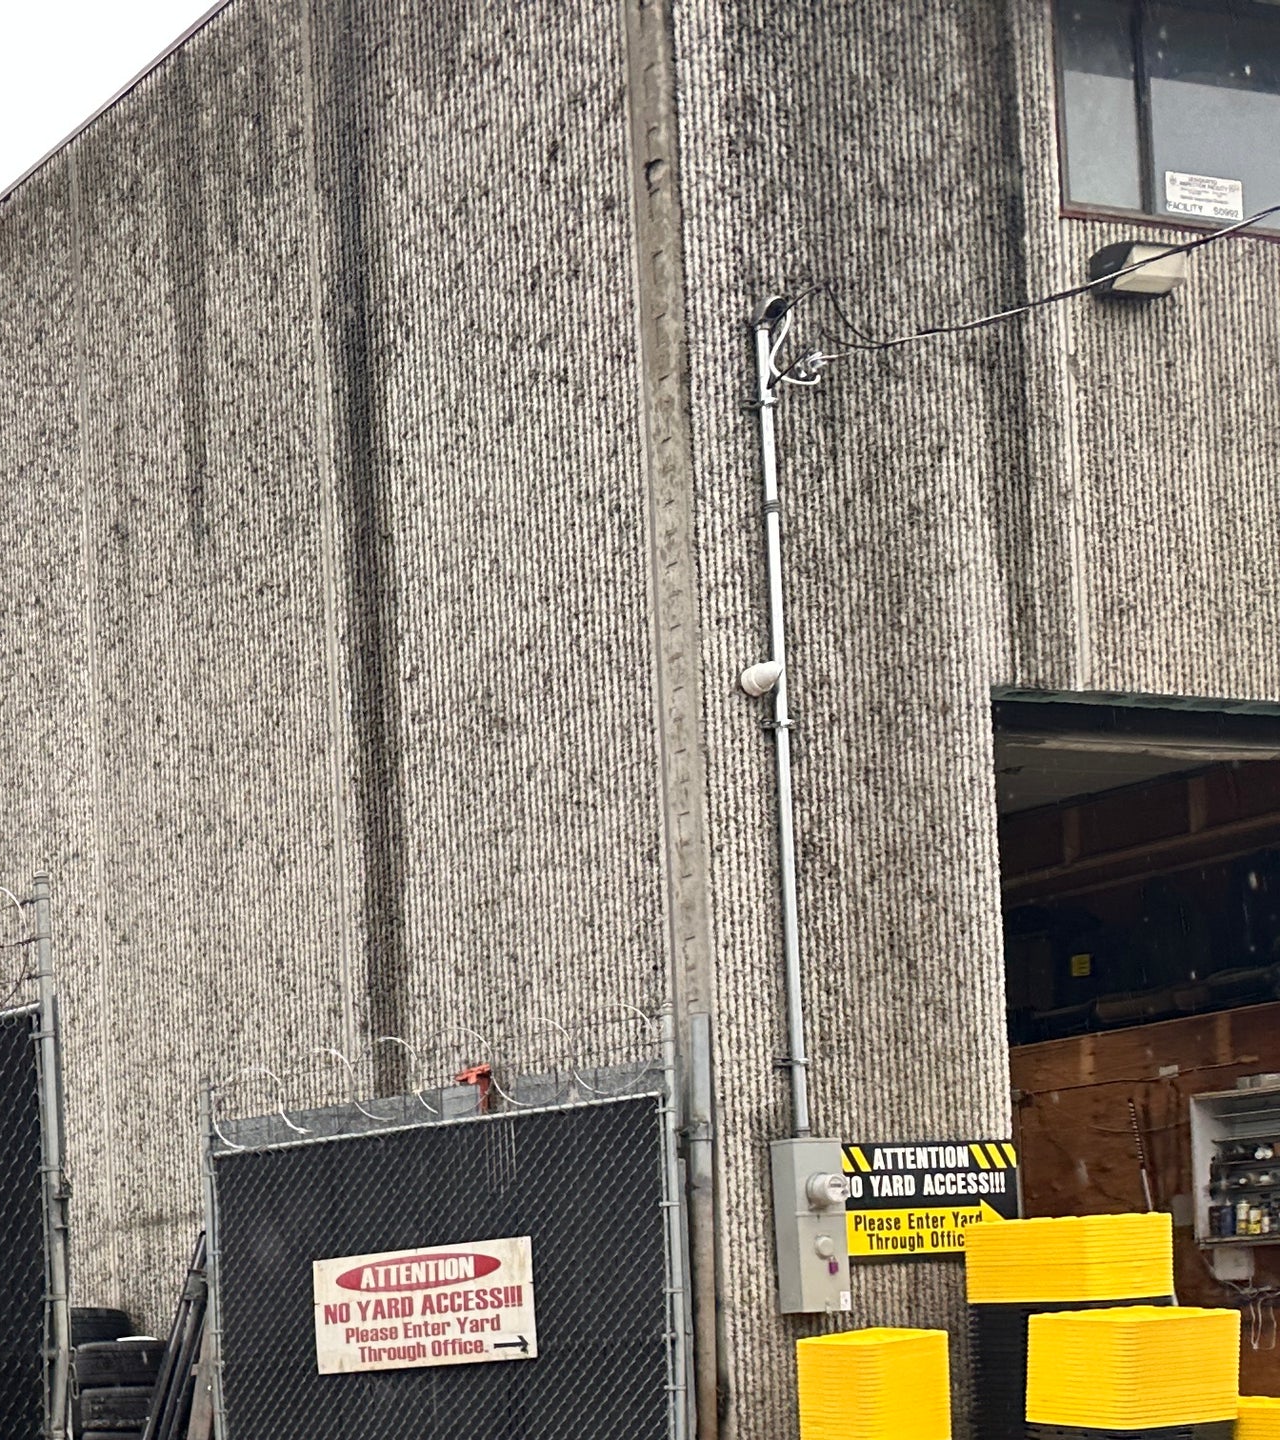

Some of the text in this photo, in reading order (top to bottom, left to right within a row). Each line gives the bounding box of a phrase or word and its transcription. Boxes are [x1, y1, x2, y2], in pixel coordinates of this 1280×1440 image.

[872, 1145, 970, 1171] ATTENTION
[869, 1174, 916, 1197] YARD
[923, 1172, 1006, 1195] ACCESS!!!
[854, 1214, 901, 1231] Please
[908, 1213, 945, 1230] Enter
[866, 1232, 924, 1251] Through
[360, 1256, 475, 1290] ATTENTION
[324, 1285, 523, 1325] NO YARD ACCESS!!!
[345, 1314, 501, 1344] Please Enter Yard
[358, 1341, 427, 1363] Through
